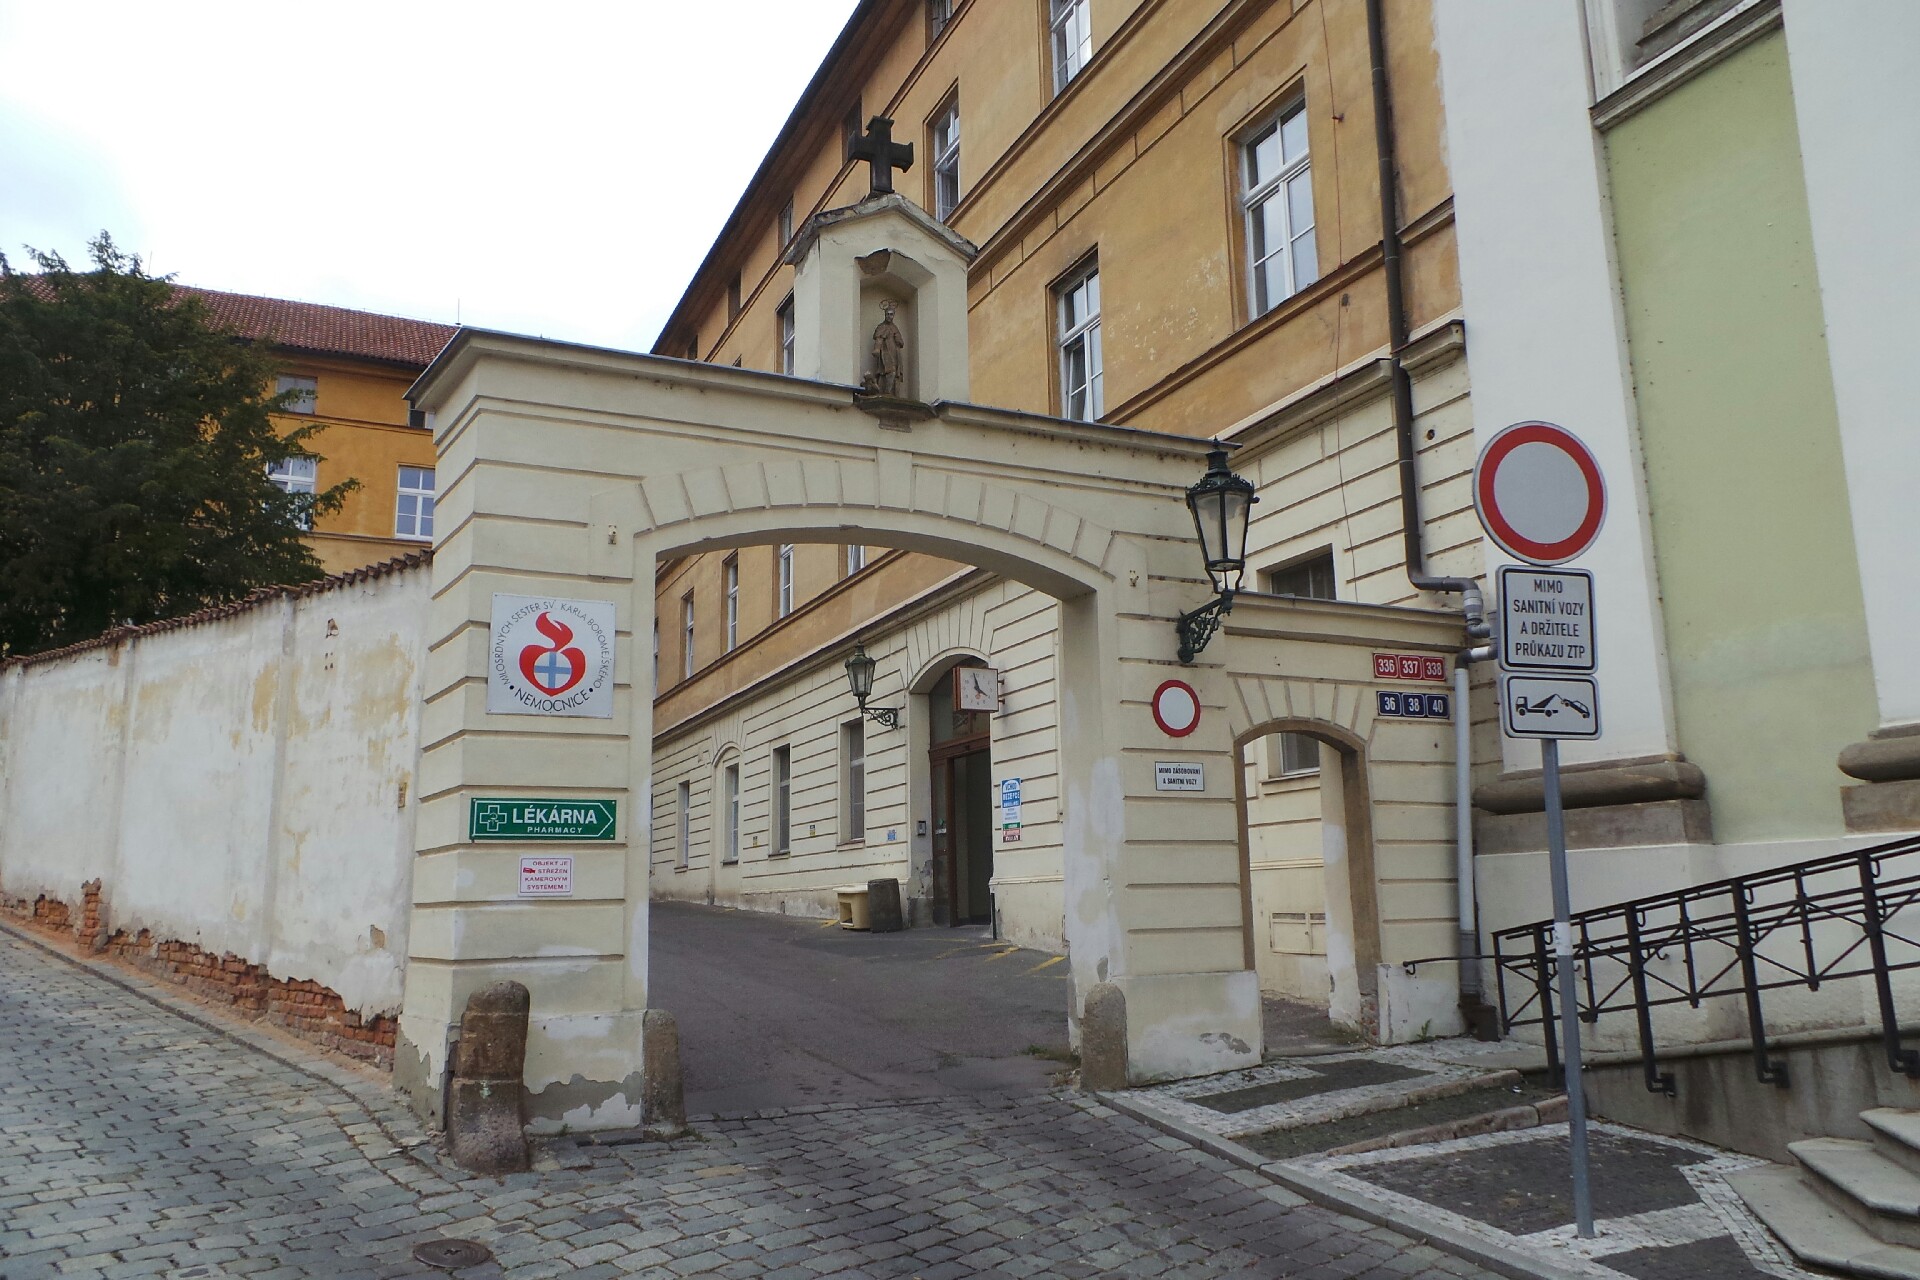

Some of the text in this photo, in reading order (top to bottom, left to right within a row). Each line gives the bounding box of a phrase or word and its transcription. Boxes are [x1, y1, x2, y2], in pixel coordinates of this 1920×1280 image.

[1534, 579, 1563, 593] MIMO
[511, 602, 541, 623] SESTER
[560, 603, 587, 621] KARLA
[1513, 598, 1584, 616] SANITNÍ VOZY
[1520, 619, 1580, 637] A DRŽITELE
[1515, 640, 1585, 659] PRŮKAZU ZTP
[1378, 659, 1442, 675] 336 337 338
[514, 688, 590, 712] NEMOCNICE
[1384, 697, 1444, 713] 36 38 40
[512, 804, 597, 825] LÉKÁRNA
[527, 826, 583, 834] PHARMACY
